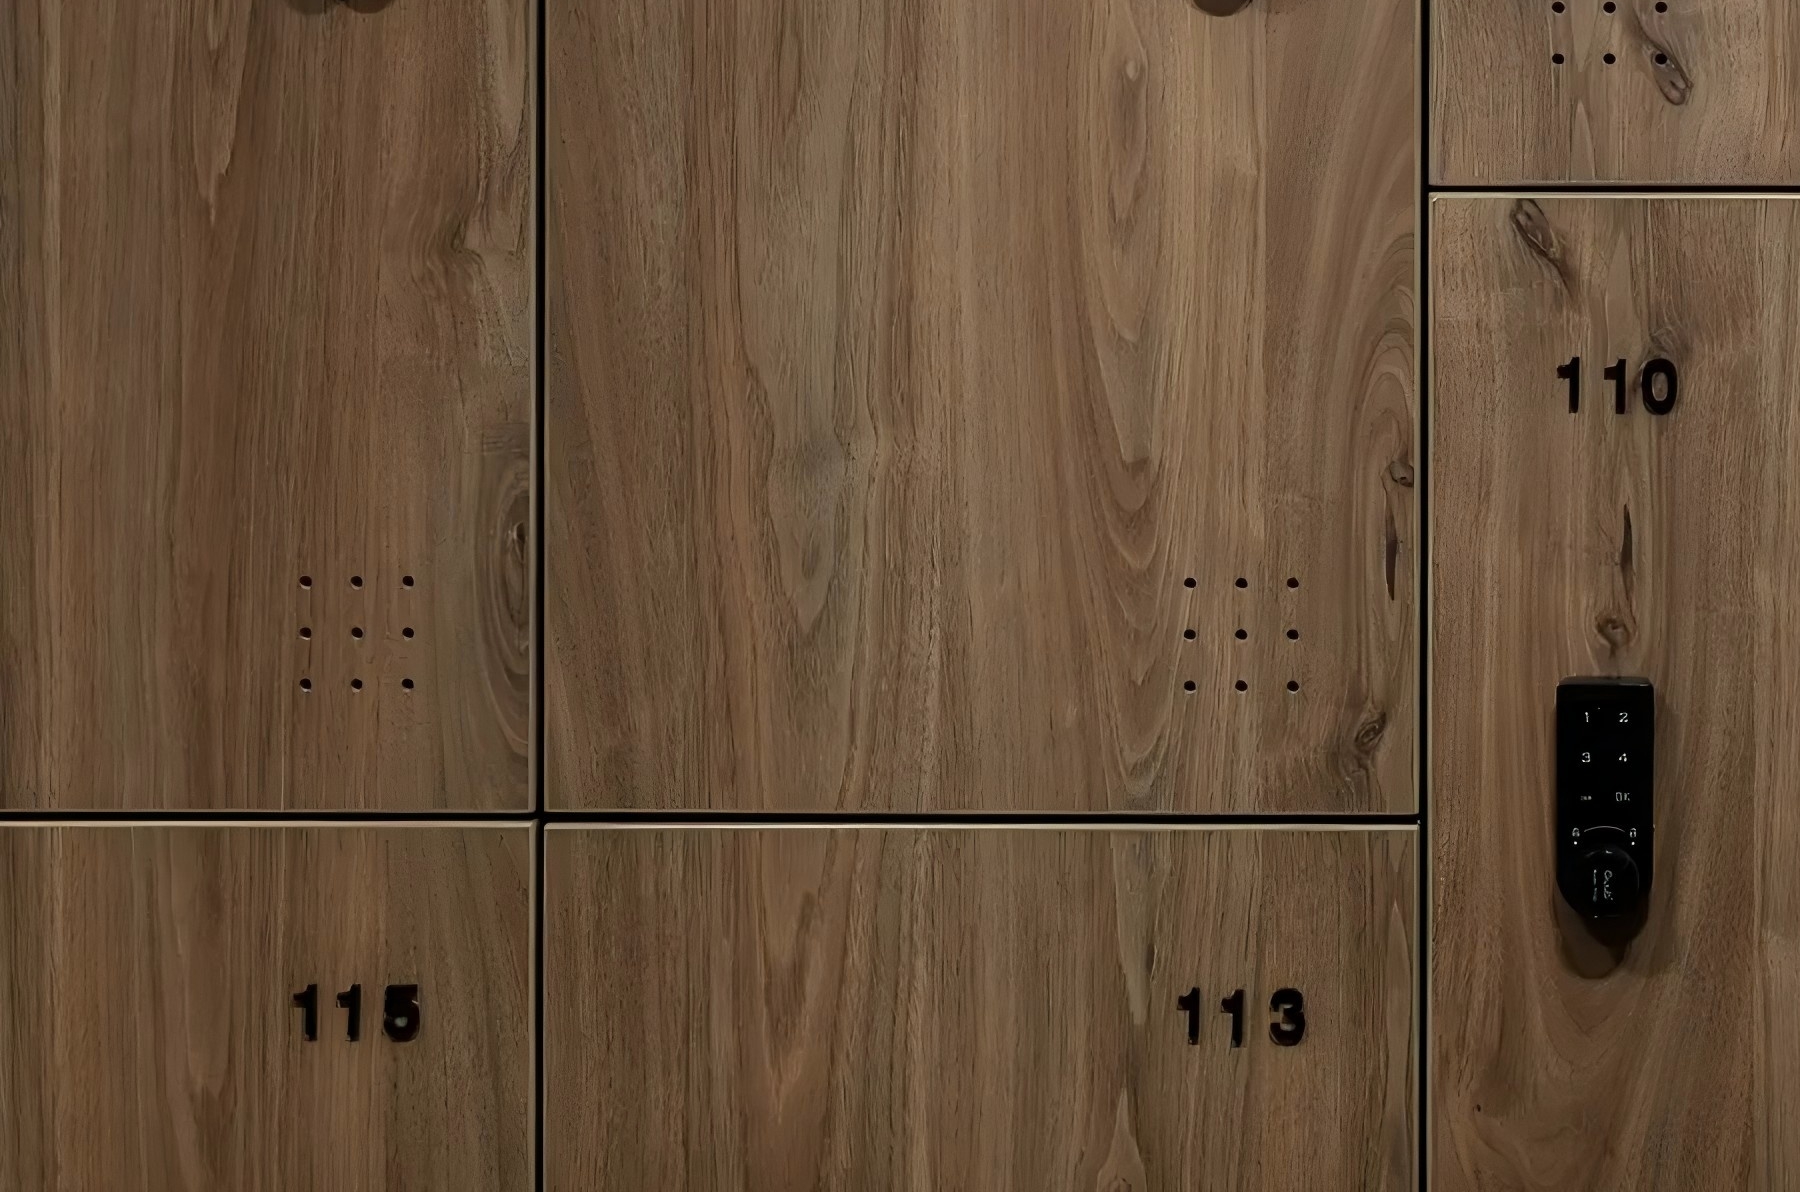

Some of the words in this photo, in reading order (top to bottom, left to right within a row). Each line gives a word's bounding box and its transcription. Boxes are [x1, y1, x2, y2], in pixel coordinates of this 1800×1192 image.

[1557, 357, 1678, 415] 110
[1585, 712, 1590, 723] 1
[1619, 712, 1629, 723] 2
[1581, 752, 1591, 763] 3
[290, 983, 421, 1044] 115
[1177, 986, 1307, 1048] 113
